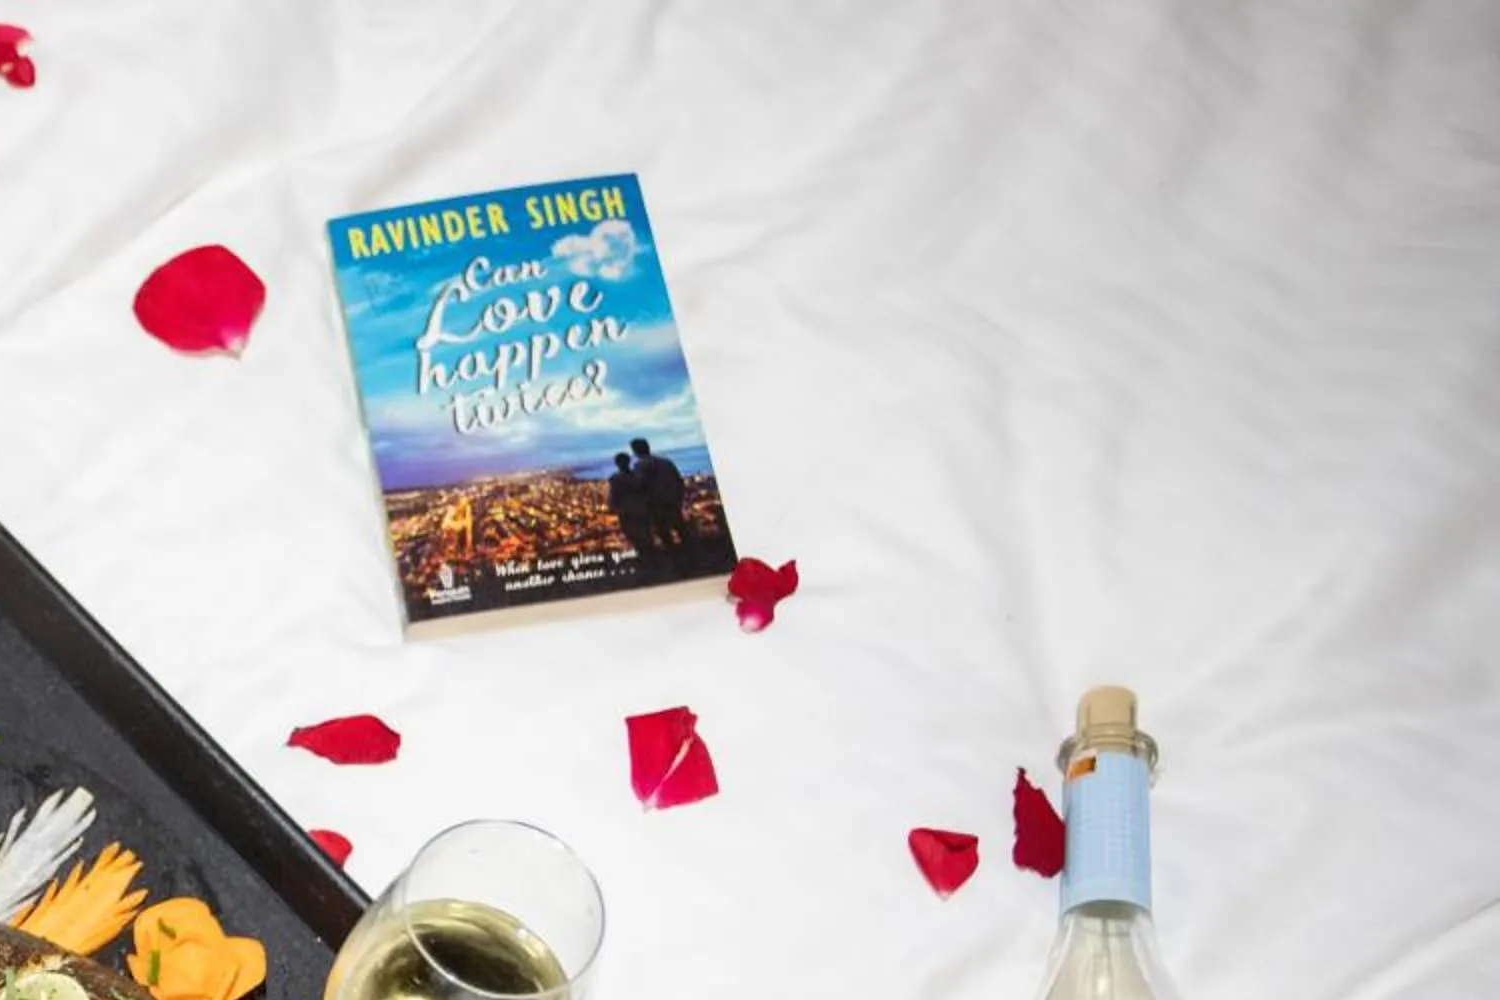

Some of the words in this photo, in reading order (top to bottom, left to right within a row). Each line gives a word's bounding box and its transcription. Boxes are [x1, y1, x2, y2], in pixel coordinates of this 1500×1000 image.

[347, 202, 511, 260] RAVINDER
[525, 186, 627, 230] SINGH
[464, 255, 547, 291] Can
[415, 275, 604, 349] Love
[417, 315, 628, 396] happen
[494, 559, 531, 578] When
[536, 557, 565, 573] love
[611, 547, 638, 564] you
[505, 574, 555, 592] another
[561, 567, 604, 584] chance
